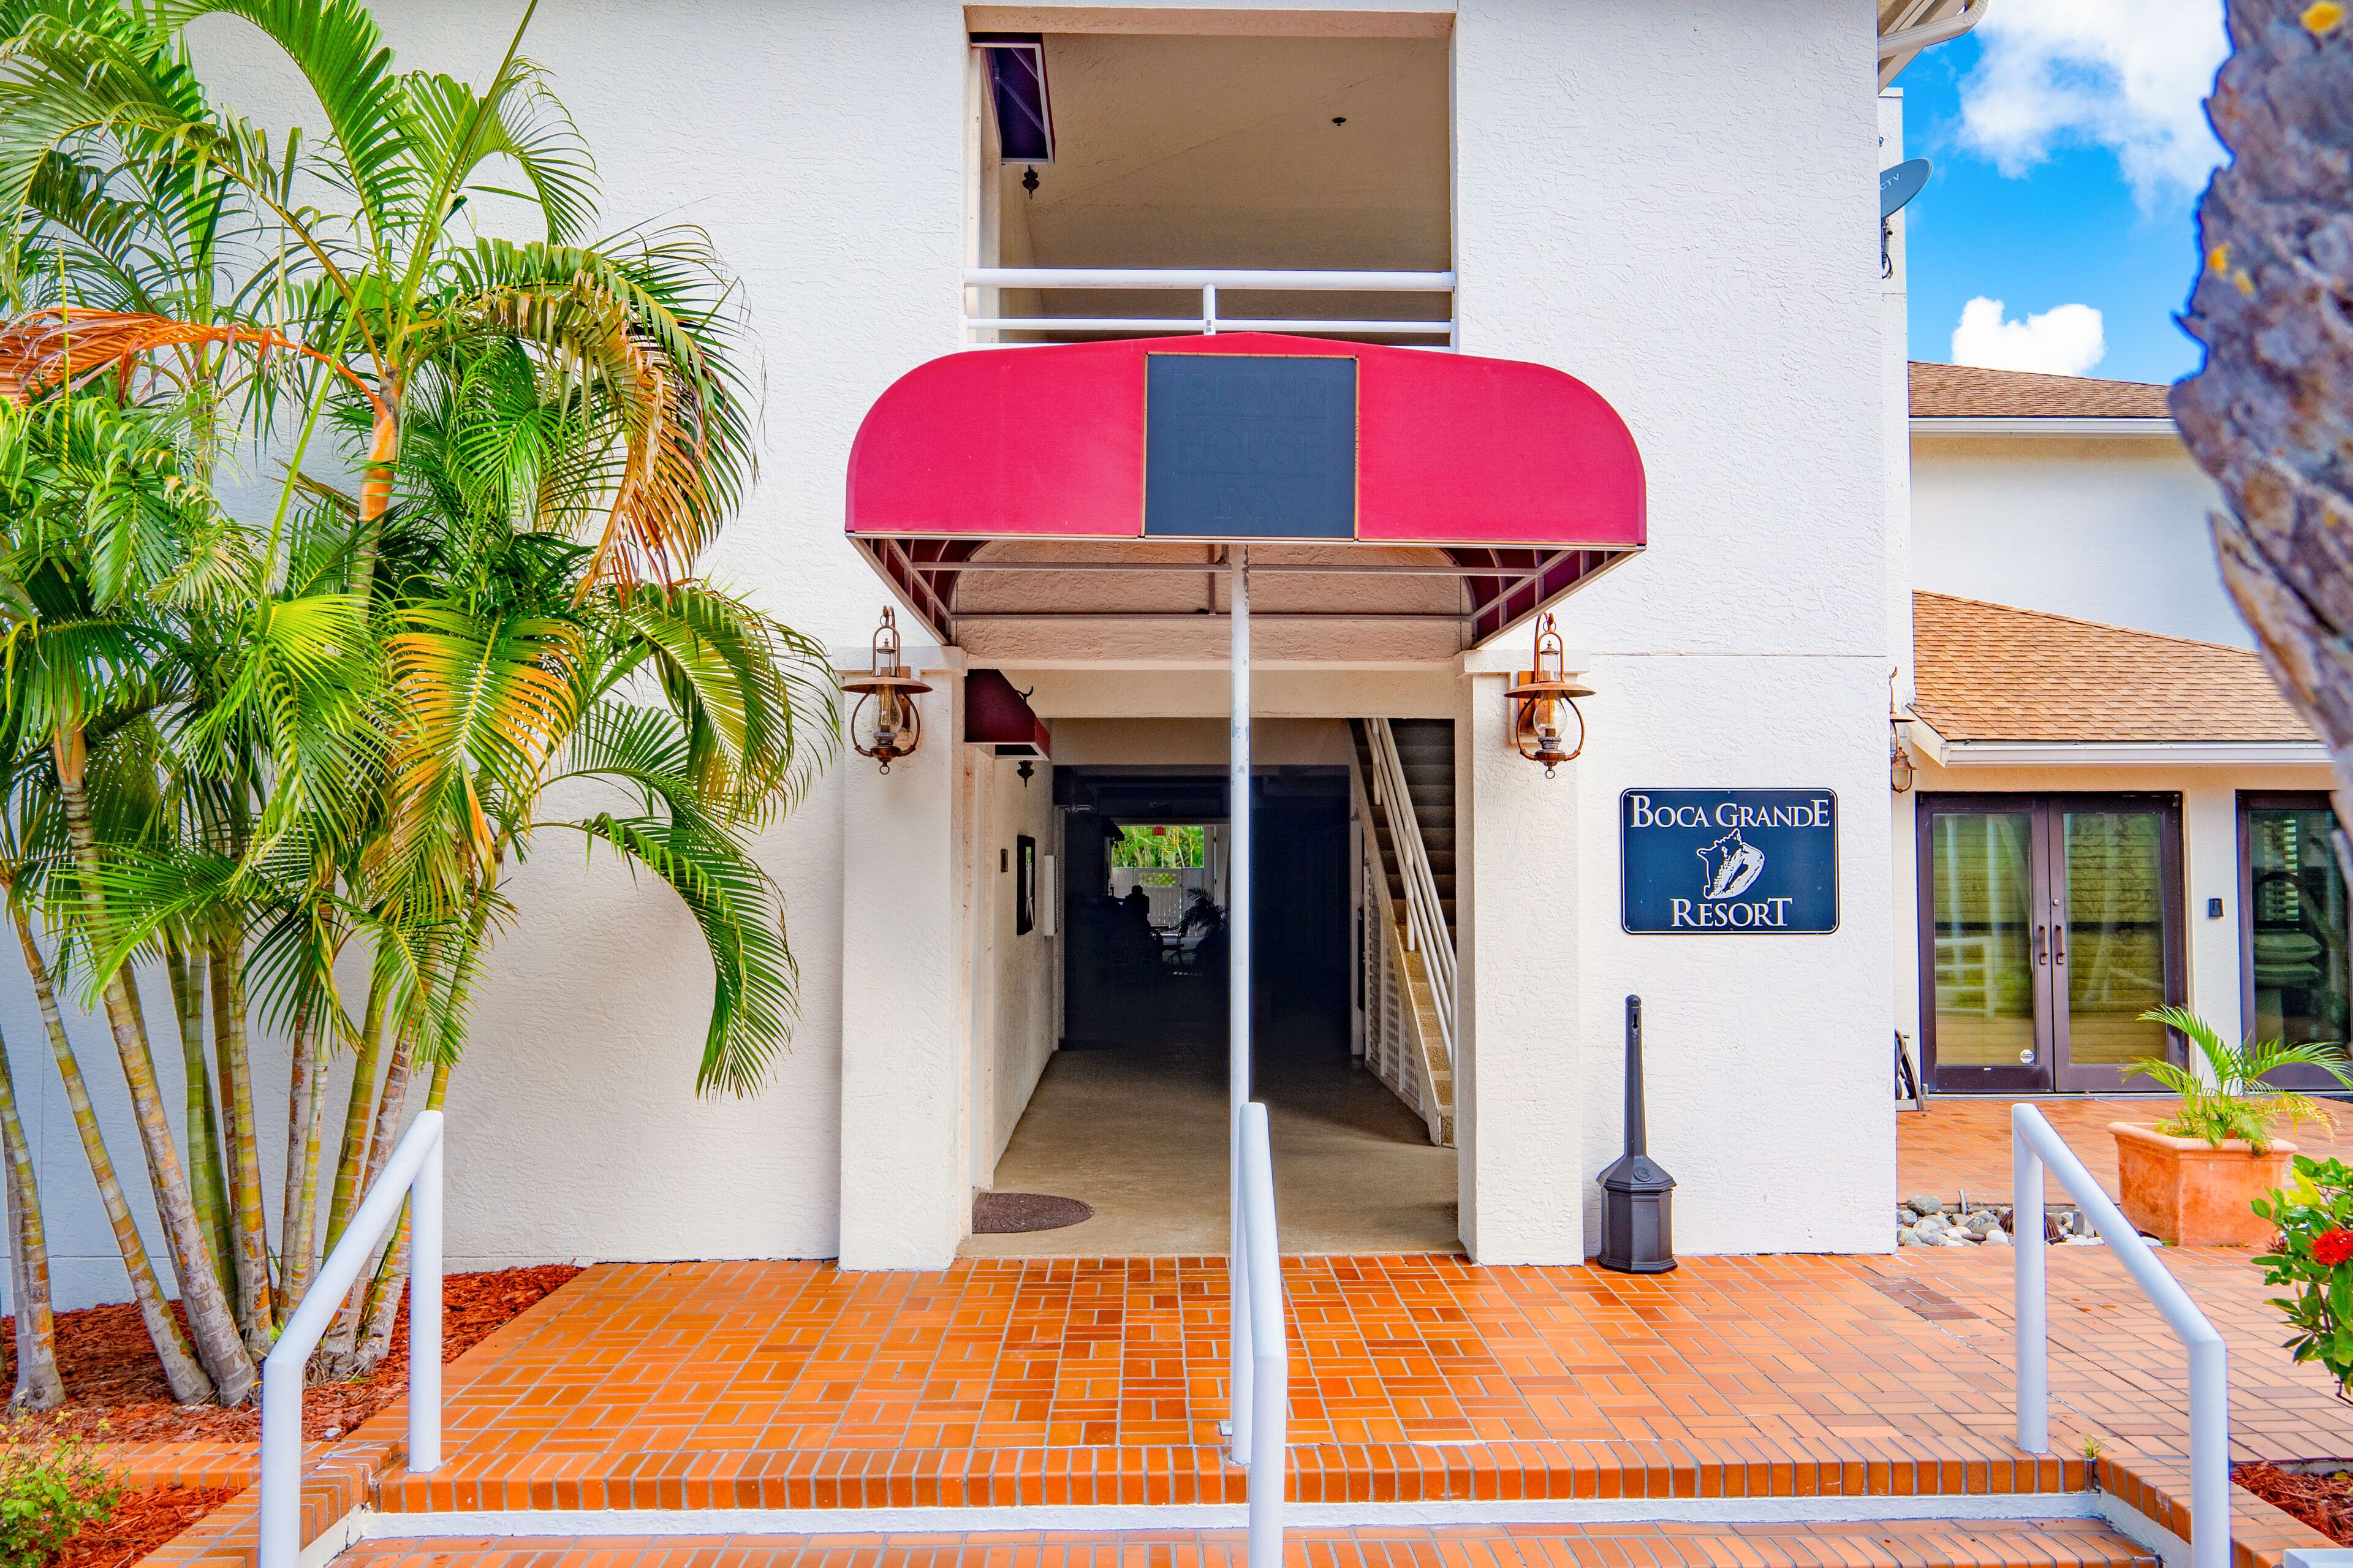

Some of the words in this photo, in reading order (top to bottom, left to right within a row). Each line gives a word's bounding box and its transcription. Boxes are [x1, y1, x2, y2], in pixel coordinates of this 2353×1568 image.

[1174, 374, 1327, 409] ISLAND
[1177, 430, 1324, 464] HOUSE
[1214, 488, 1284, 521] INN
[1630, 795, 1711, 828] BOCA
[1716, 799, 1830, 828] GRANDE
[1670, 898, 1793, 928] RESORT
